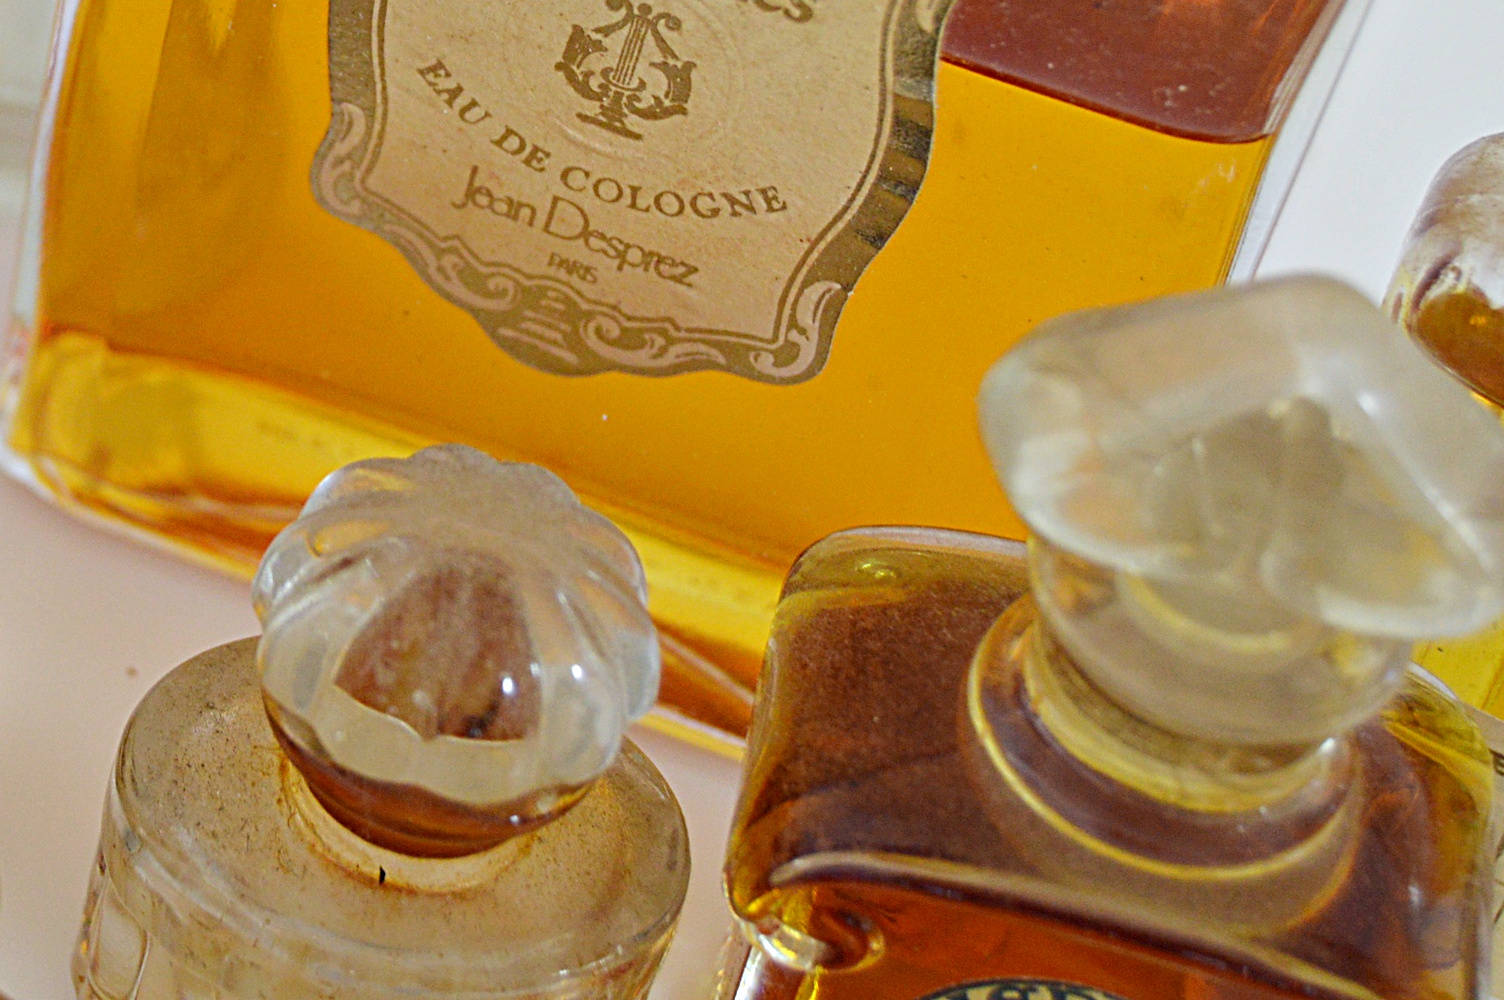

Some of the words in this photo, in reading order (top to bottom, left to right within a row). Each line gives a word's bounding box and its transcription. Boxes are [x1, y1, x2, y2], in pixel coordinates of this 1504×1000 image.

[417, 58, 492, 126] EAU
[490, 125, 552, 172] DE
[559, 165, 788, 220] COLOGNE
[451, 165, 537, 229] Jean
[543, 194, 700, 287] Desprez
[548, 252, 599, 285] PARIS
